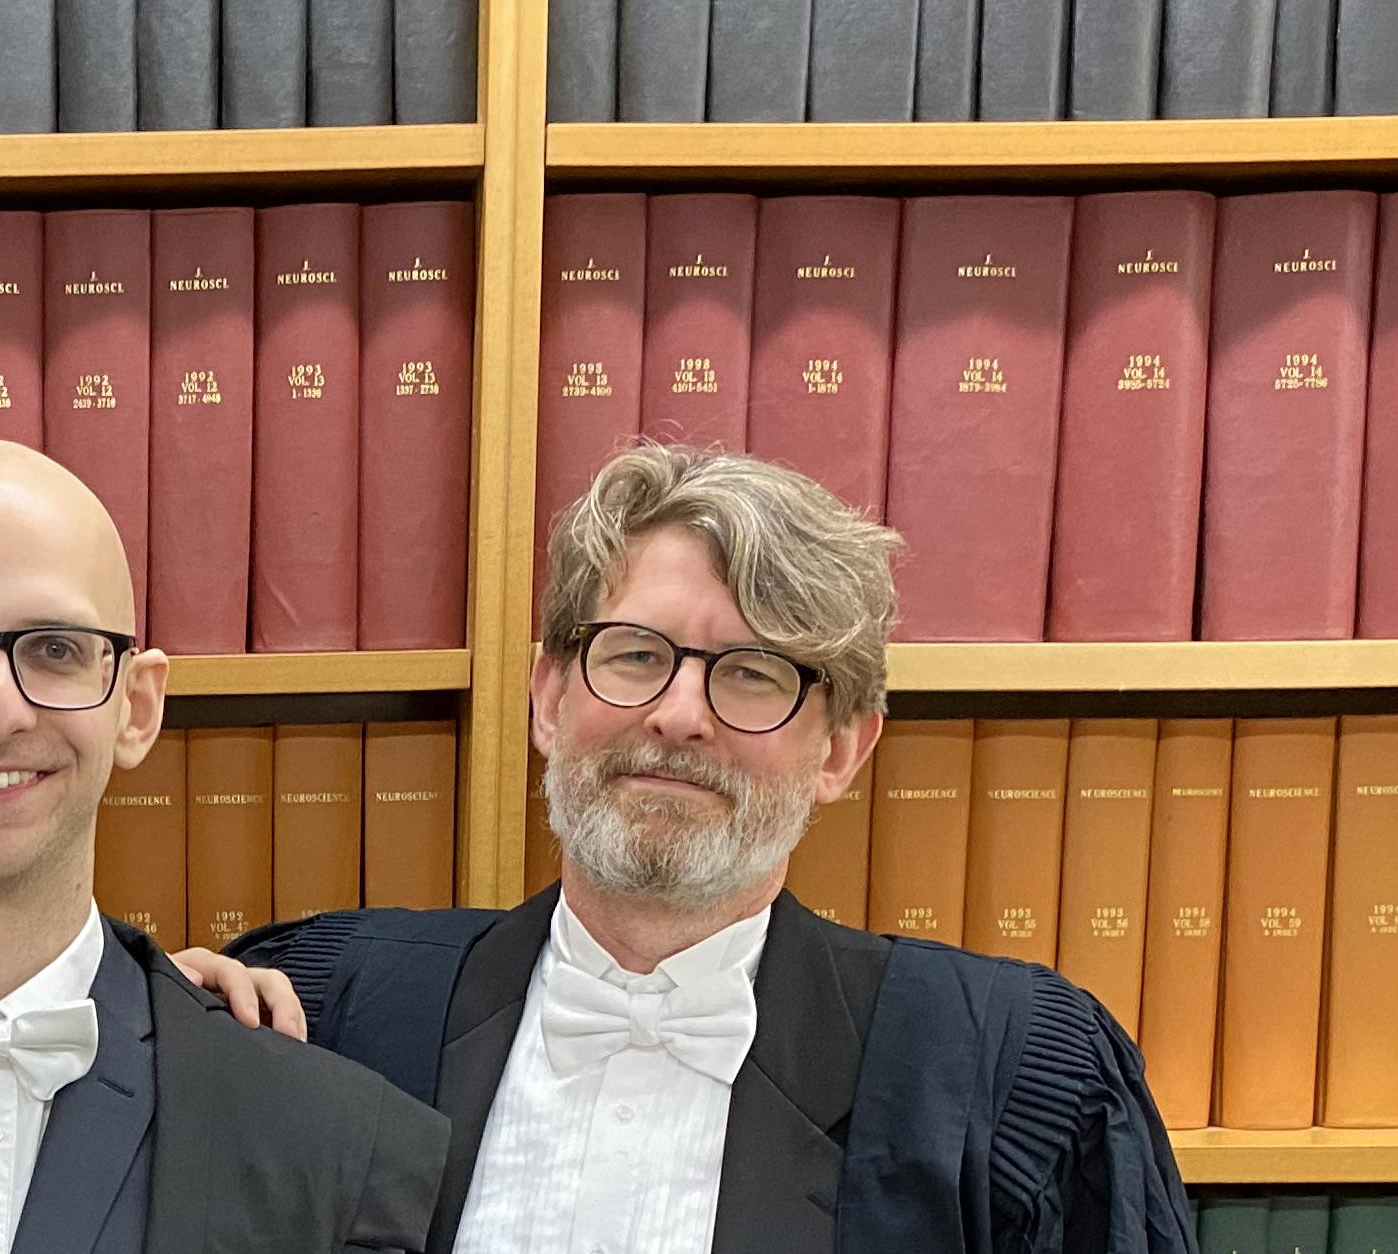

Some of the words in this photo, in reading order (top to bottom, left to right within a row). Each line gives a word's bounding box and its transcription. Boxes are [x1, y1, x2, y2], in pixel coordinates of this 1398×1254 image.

[807, 360, 838, 371] 1994
[968, 359, 1000, 370] 1994
[1128, 355, 1161, 368] 1994
[1285, 355, 1318, 366] 1994
[290, 365, 322, 376] 1993
[401, 362, 433, 374] 1993
[78, 375, 110, 386] 1992
[184, 371, 215, 384] 1992
[1266, 908, 1296, 918] 1994
